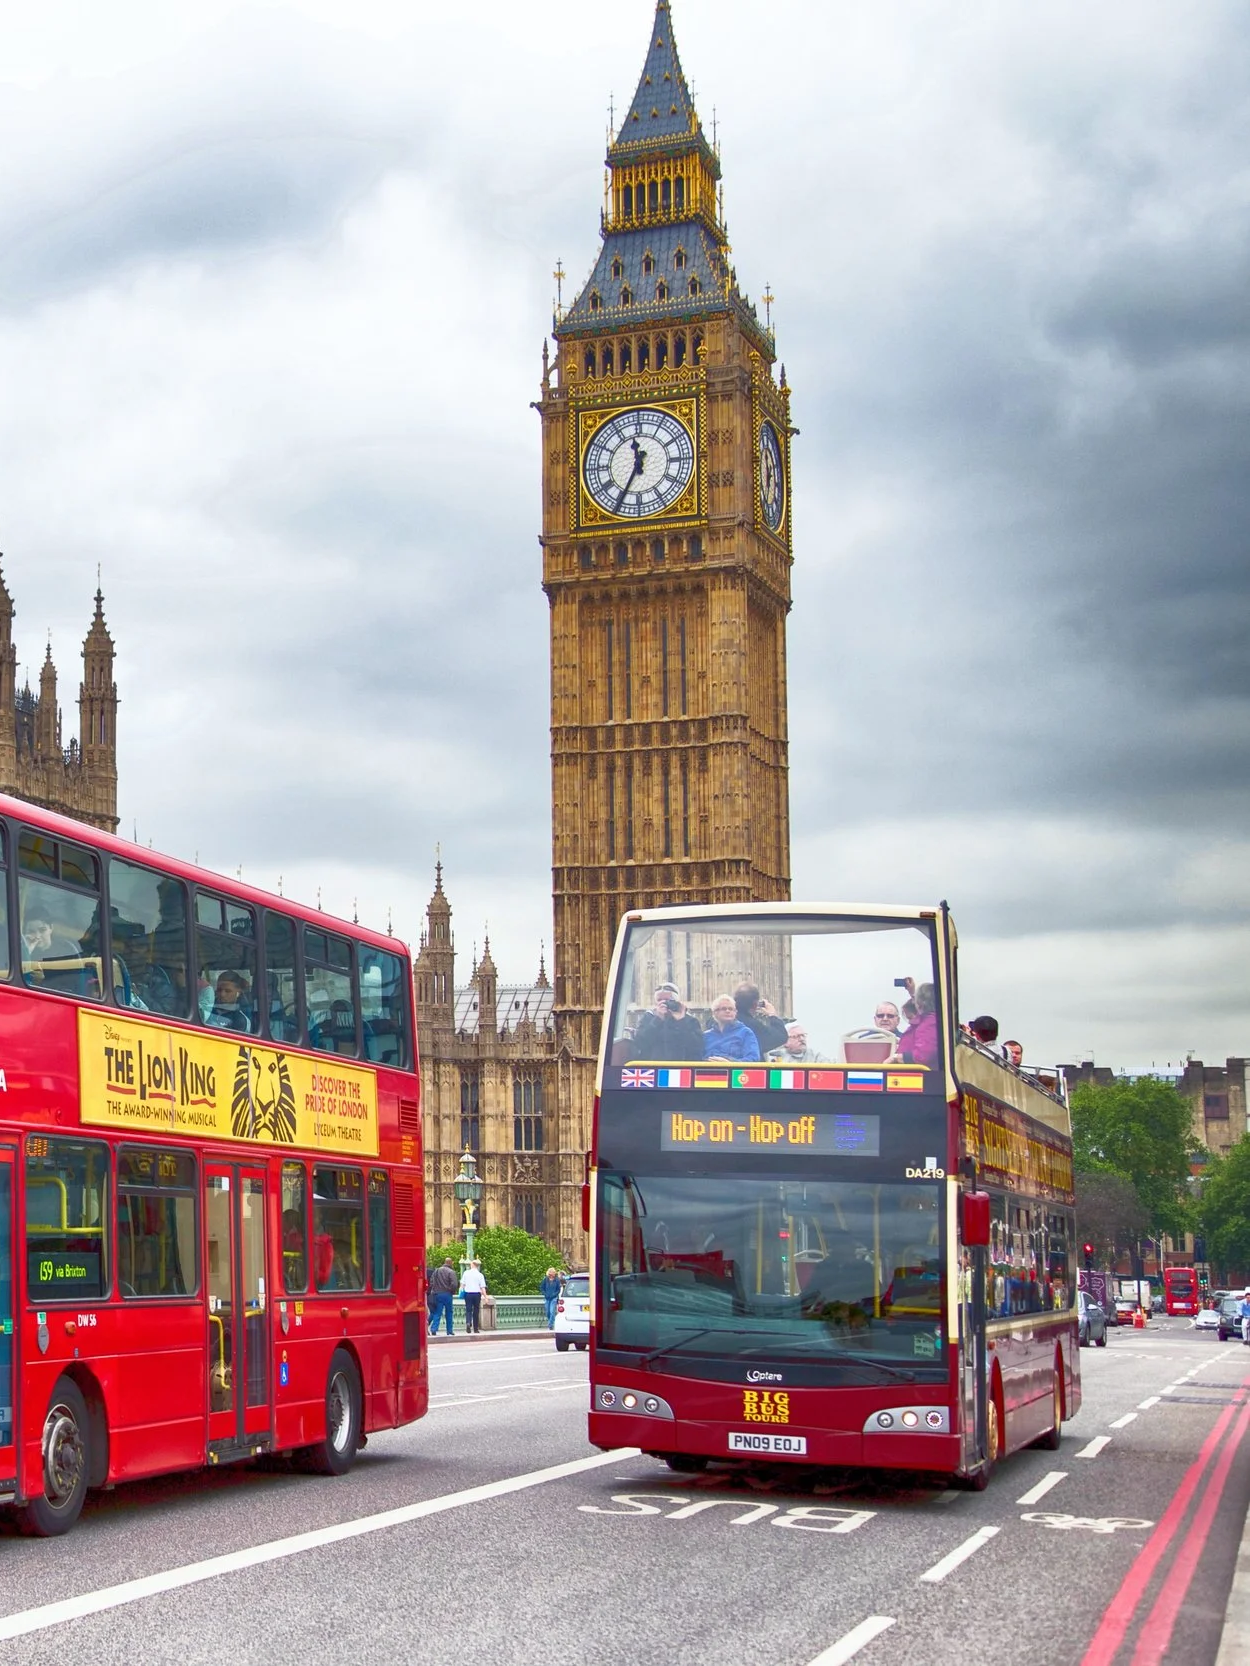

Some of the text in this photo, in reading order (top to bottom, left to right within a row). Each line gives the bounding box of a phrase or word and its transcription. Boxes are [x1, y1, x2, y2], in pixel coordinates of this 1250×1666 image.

[104, 1040, 216, 1106] THE LION KING
[311, 1074, 361, 1099] DISCOVER THE
[106, 1100, 217, 1127] THE AWARD-WINNING MUSICAL
[305, 1093, 368, 1120] PRIDE OF LONDON
[313, 1122, 362, 1141] LYCEUM THEATRE
[671, 1113, 706, 1143] Hop
[709, 1119, 733, 1142] on
[750, 1115, 785, 1144] Hop
[788, 1116, 816, 1144] off
[905, 1168, 945, 1179] DA219
[40, 1261, 87, 1281] 159 via Brixton
[77, 1313, 97, 1327] DW 56
[752, 1370, 783, 1381] Optare
[743, 1390, 790, 1404] BIG
[743, 1402, 790, 1416] BUS
[743, 1413, 789, 1424] TOURS
[734, 1435, 770, 1450] PN09
[577, 1494, 878, 1534] BUS
